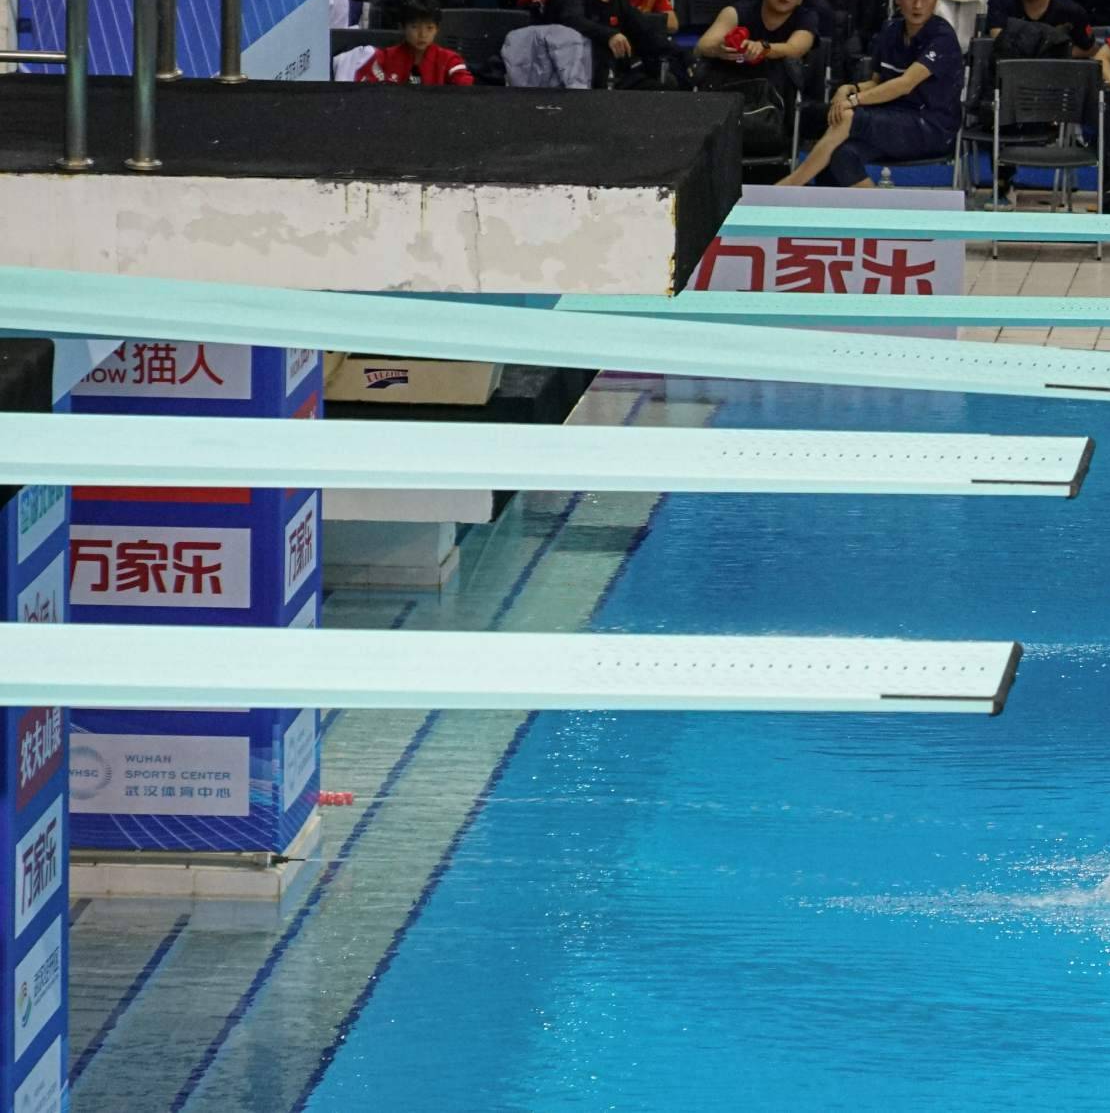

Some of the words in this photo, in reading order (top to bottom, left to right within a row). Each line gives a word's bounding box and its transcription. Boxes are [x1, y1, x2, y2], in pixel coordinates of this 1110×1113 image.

[132, 343, 224, 385] 猫人
[70, 539, 223, 594] 万家乐
[125, 754, 172, 764] WUHAN
[125, 770, 177, 780] SPORTS
[181, 771, 231, 781] CENTER
[125, 785, 231, 799] 武汉体育中心
[21, 817, 57, 916] 万家乐
